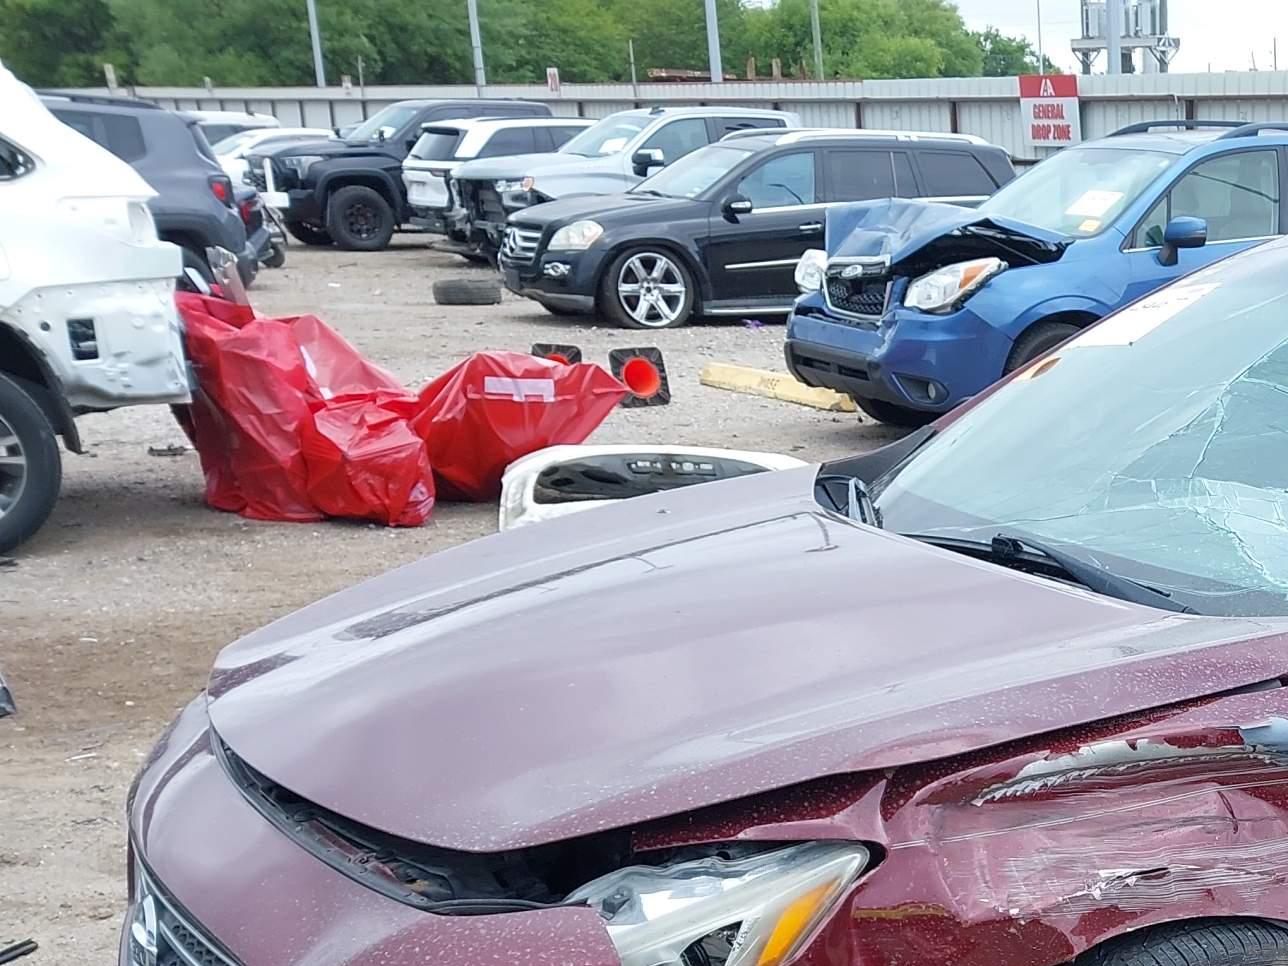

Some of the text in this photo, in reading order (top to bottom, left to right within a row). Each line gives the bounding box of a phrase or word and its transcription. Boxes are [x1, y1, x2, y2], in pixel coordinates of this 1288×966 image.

[1032, 103, 1065, 120] GENERAL
[1031, 123, 1072, 141] DROP ZONE
